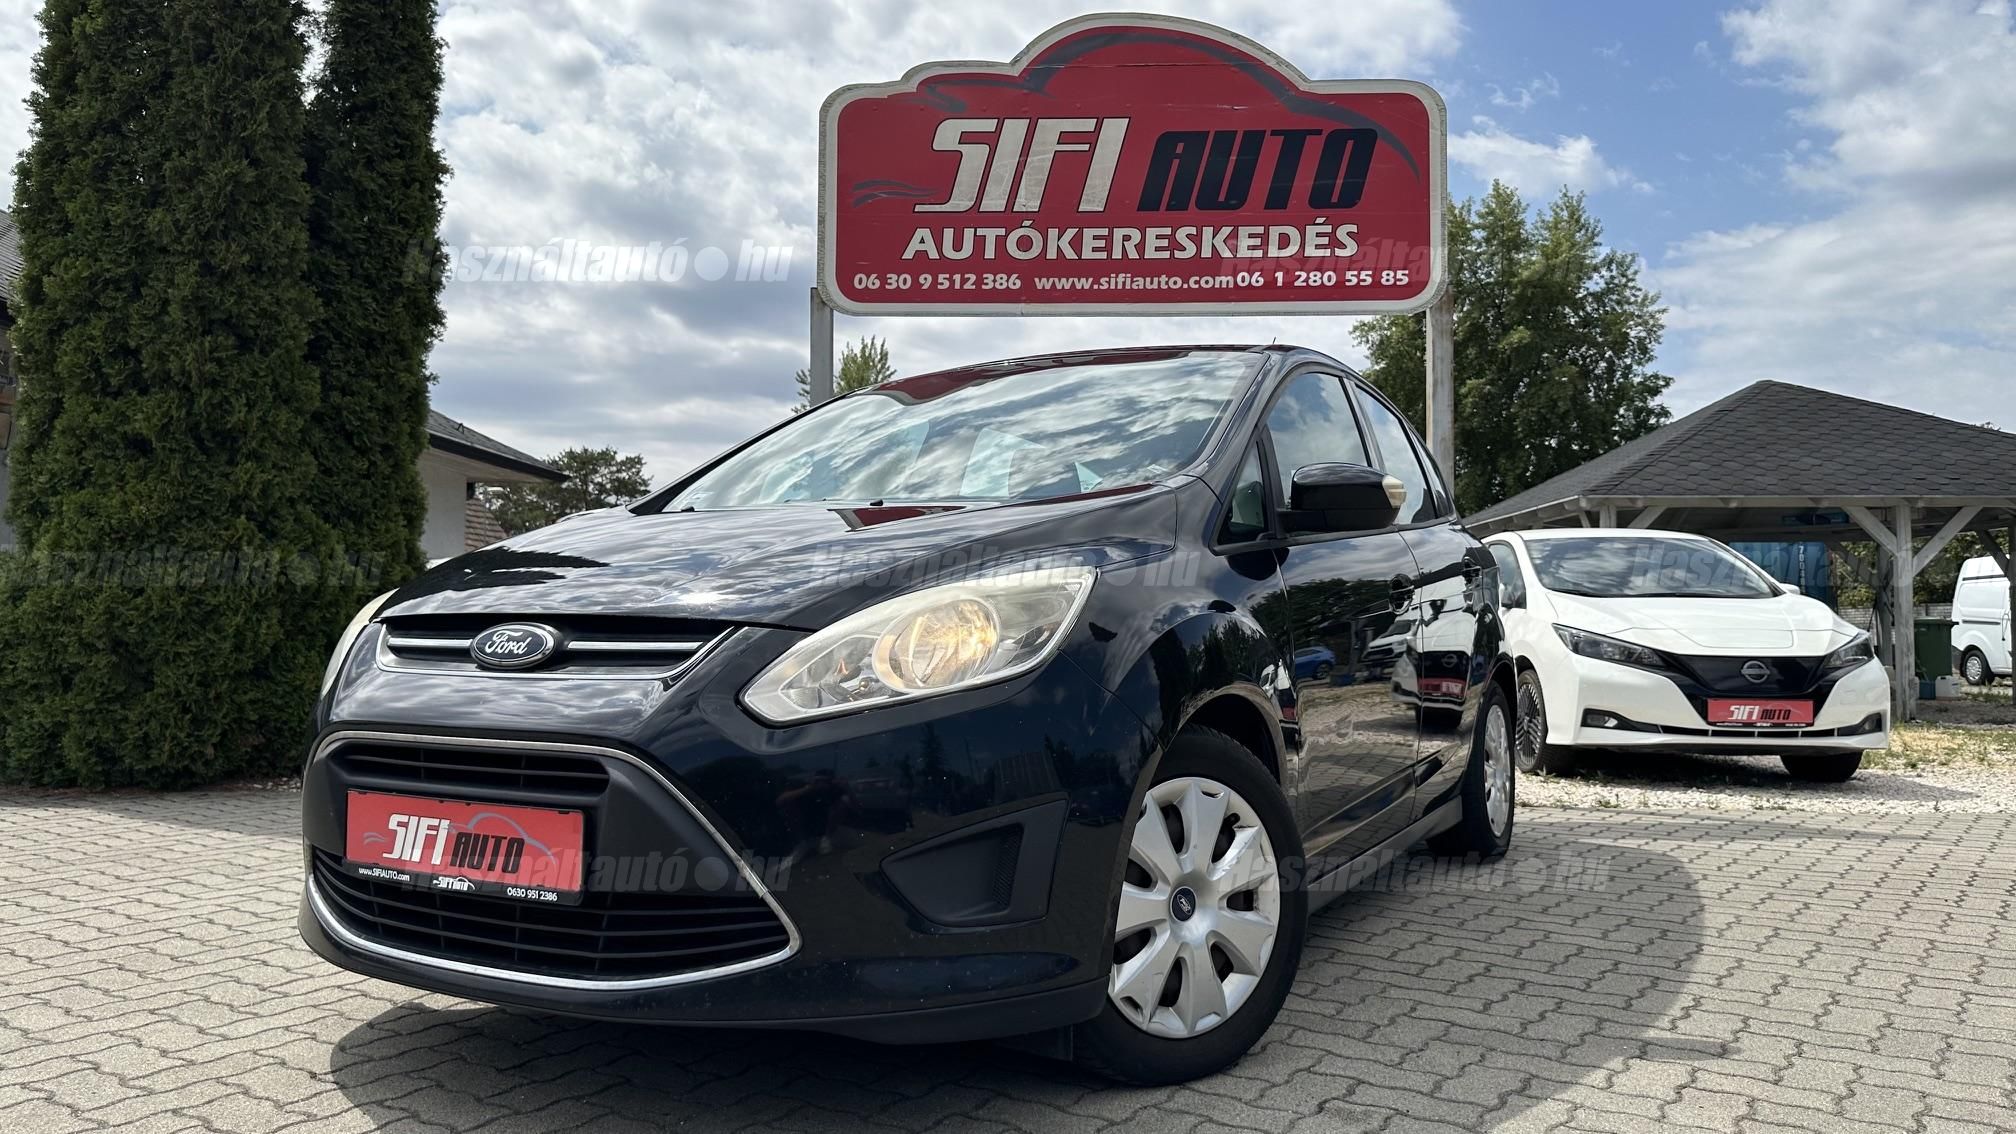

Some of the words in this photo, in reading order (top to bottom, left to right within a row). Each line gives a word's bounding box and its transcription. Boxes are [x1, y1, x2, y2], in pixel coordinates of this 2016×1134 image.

[913, 116, 1131, 213] SIFI
[1136, 128, 1379, 212] AUTO
[901, 216, 1360, 260] AUTÓKERESKEDÉS
[853, 273, 881, 290] 06
[885, 273, 912, 290] 30
[981, 273, 1022, 290] 386
[1034, 273, 1234, 290] www.sifiauto.com
[1236, 271, 1264, 287] 06
[1274, 271, 1284, 287] 1
[1293, 271, 1337, 287] 280
[1345, 270, 1373, 286] 55
[1380, 270, 1409, 286] 85
[485, 630, 532, 654] Ford
[1728, 705, 1760, 720] SIFI
[1760, 709, 1791, 720] AUTO
[383, 813, 451, 865] SIFI
[450, 832, 526, 874] AUTO
[358, 867, 410, 881] www.SIFIAUTO.com
[507, 886, 526, 898] 0630
